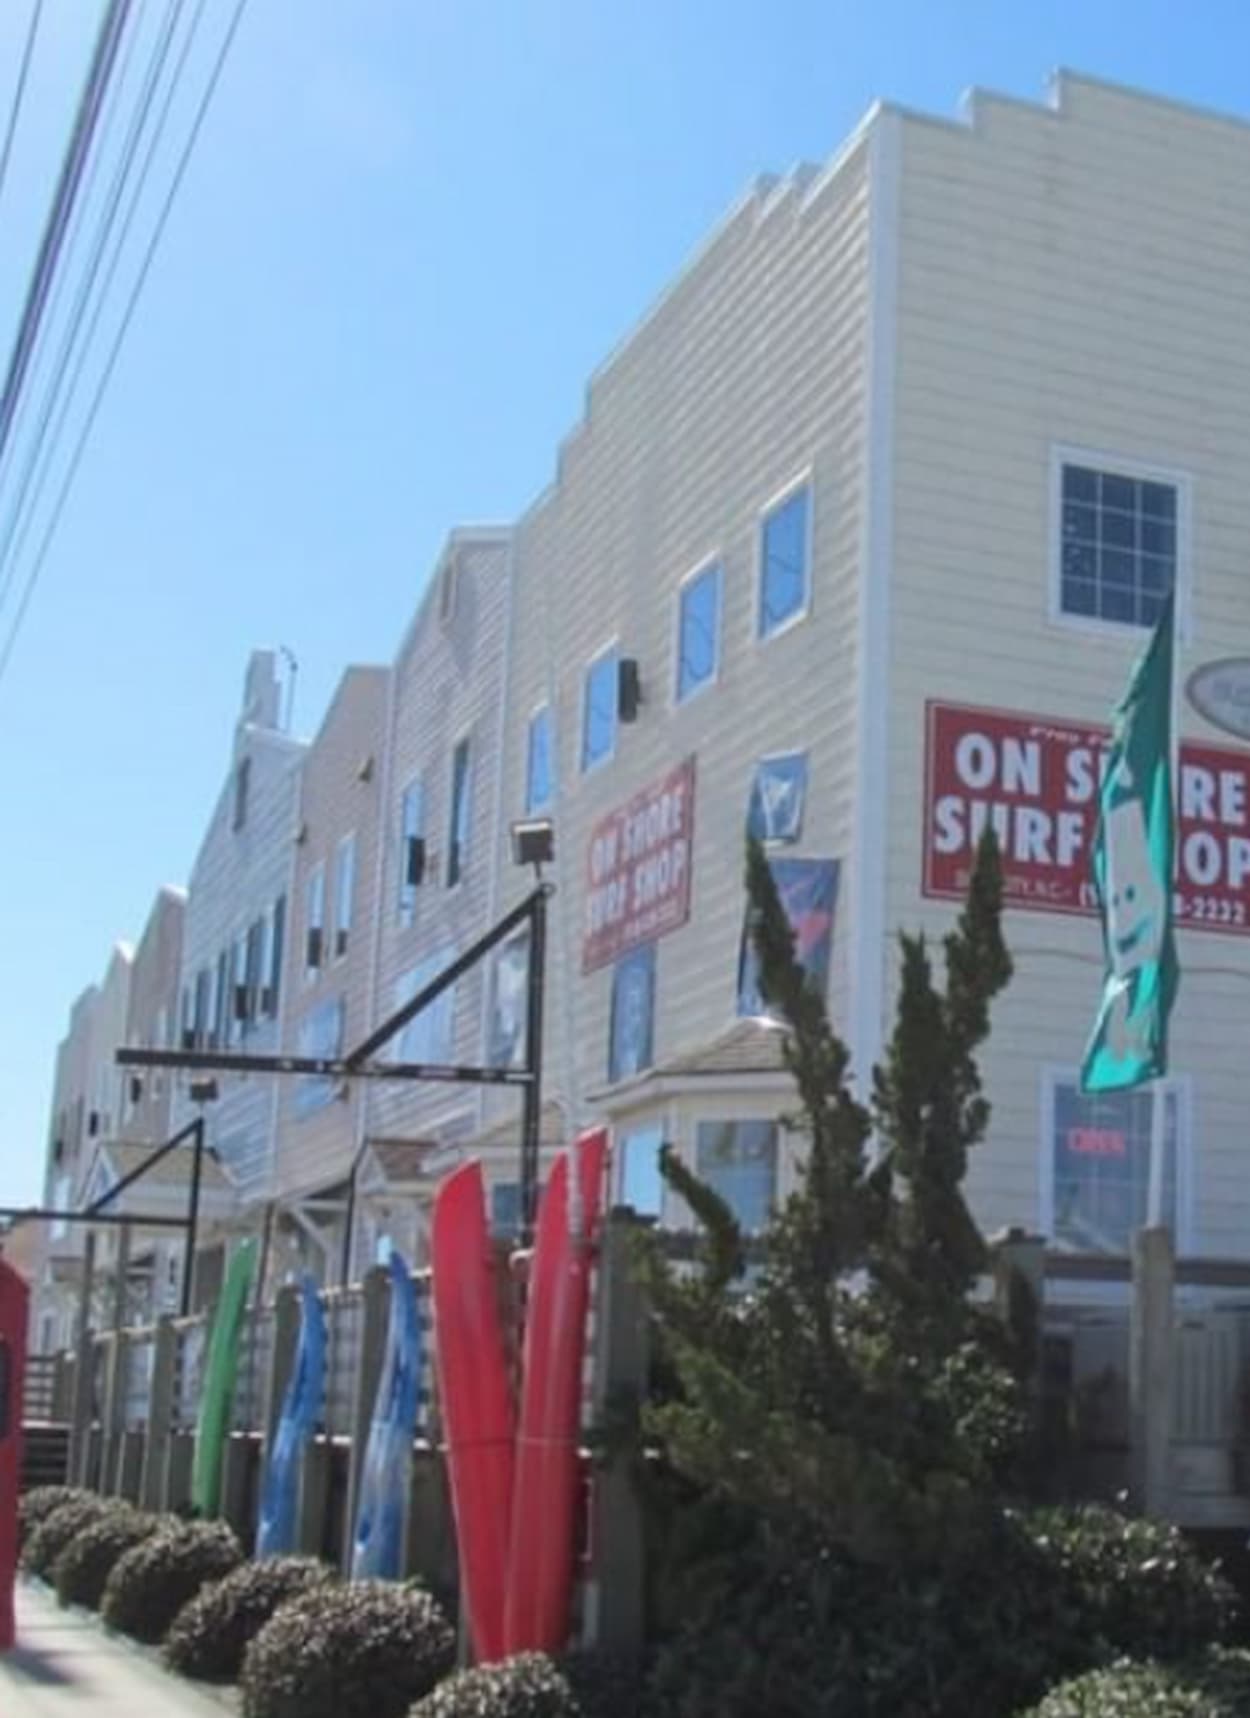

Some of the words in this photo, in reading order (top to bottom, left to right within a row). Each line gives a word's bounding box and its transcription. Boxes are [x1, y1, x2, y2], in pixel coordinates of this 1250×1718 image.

[955, 732, 1041, 795] ON
[1066, 748, 1246, 826] SRE
[934, 796, 1084, 867] SURF
[633, 839, 687, 911] SHOP
